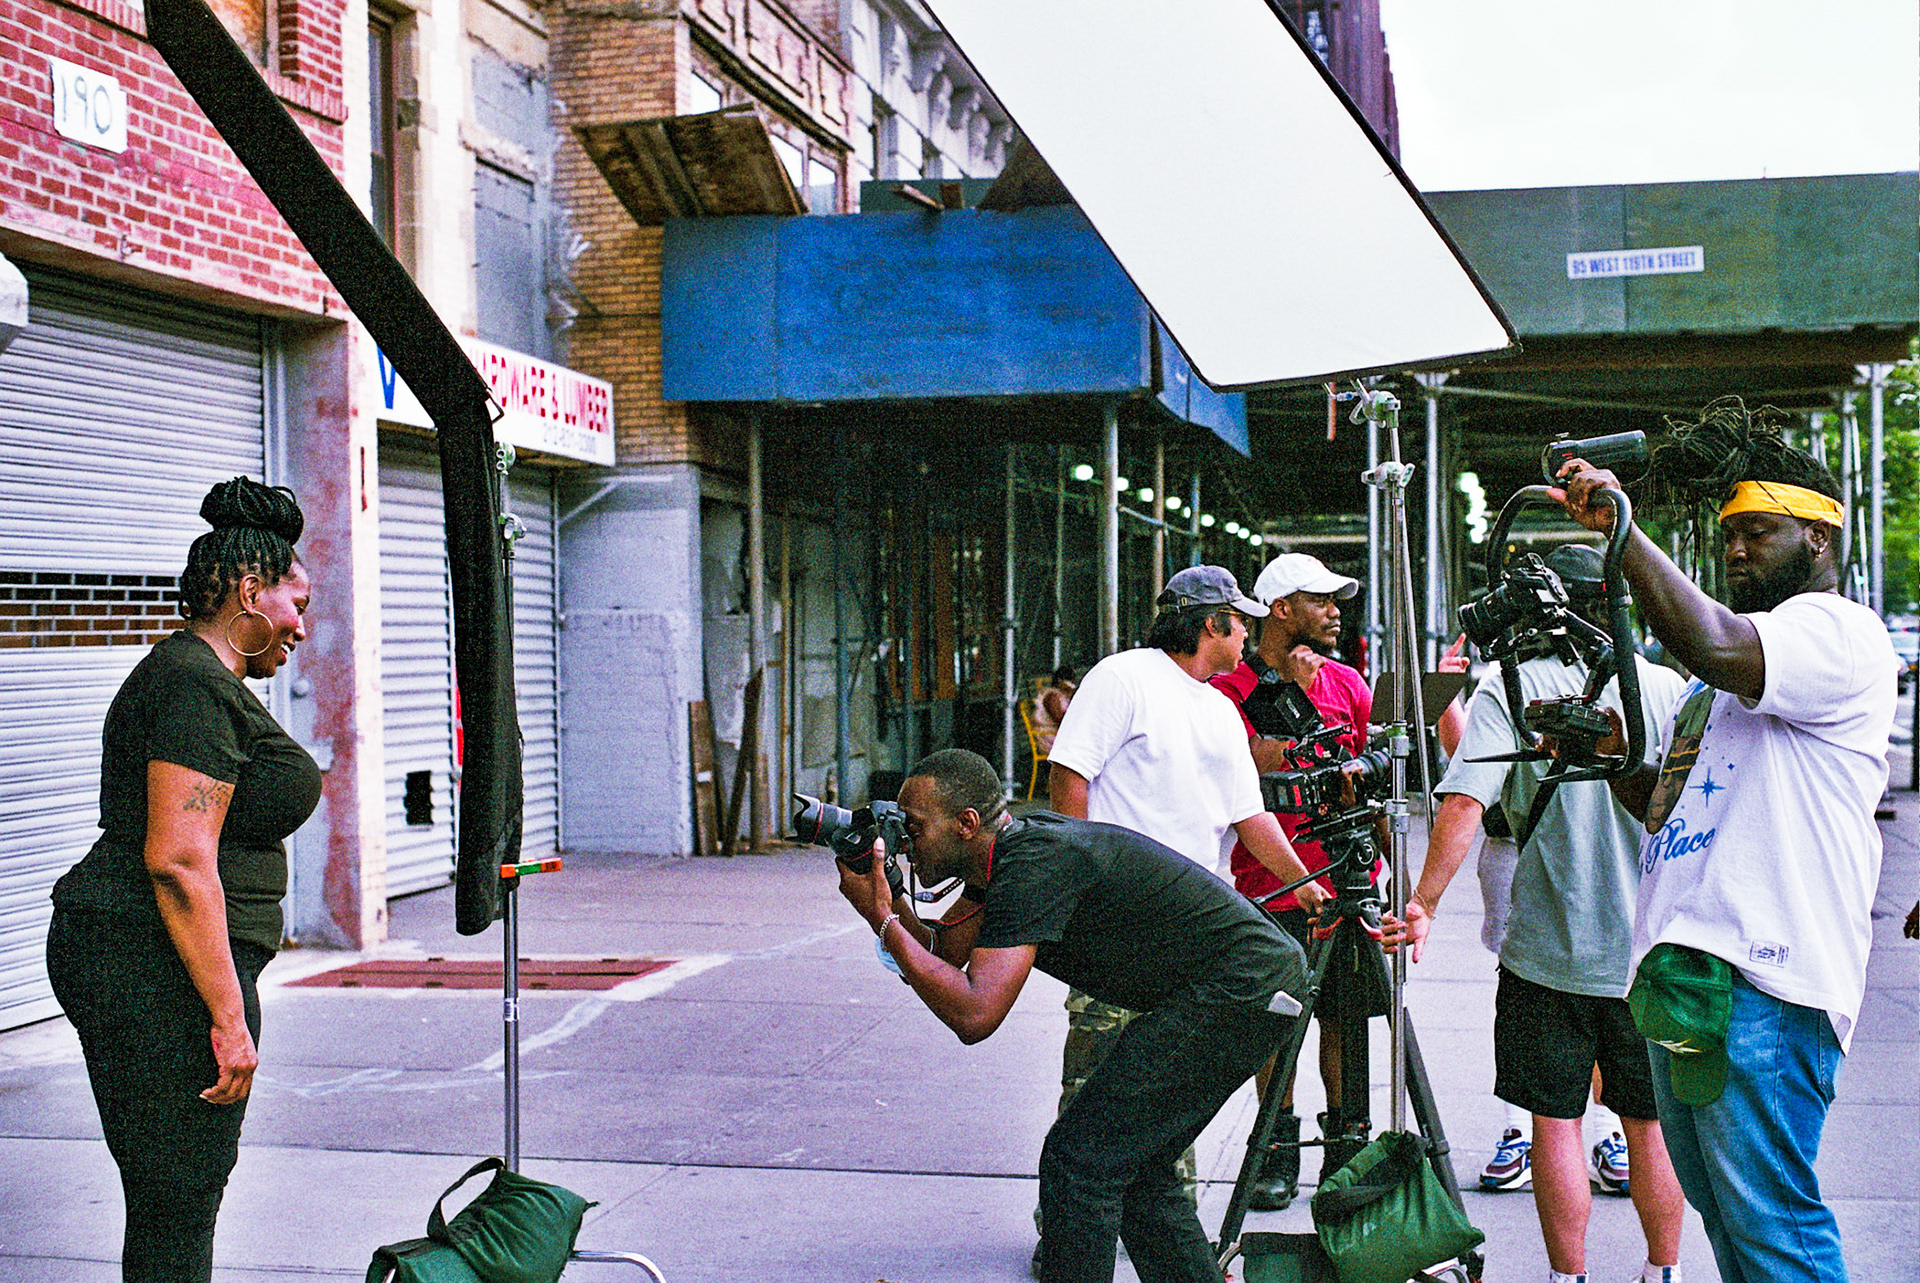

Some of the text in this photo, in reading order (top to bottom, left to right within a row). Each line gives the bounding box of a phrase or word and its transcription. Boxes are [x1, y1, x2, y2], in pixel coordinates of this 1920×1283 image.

[61, 75, 112, 134] 190
[1589, 257, 1619, 273] WEST
[1657, 250, 1696, 268] STREET
[563, 375, 610, 436] LUMBER
[1645, 817, 1716, 875] Place
